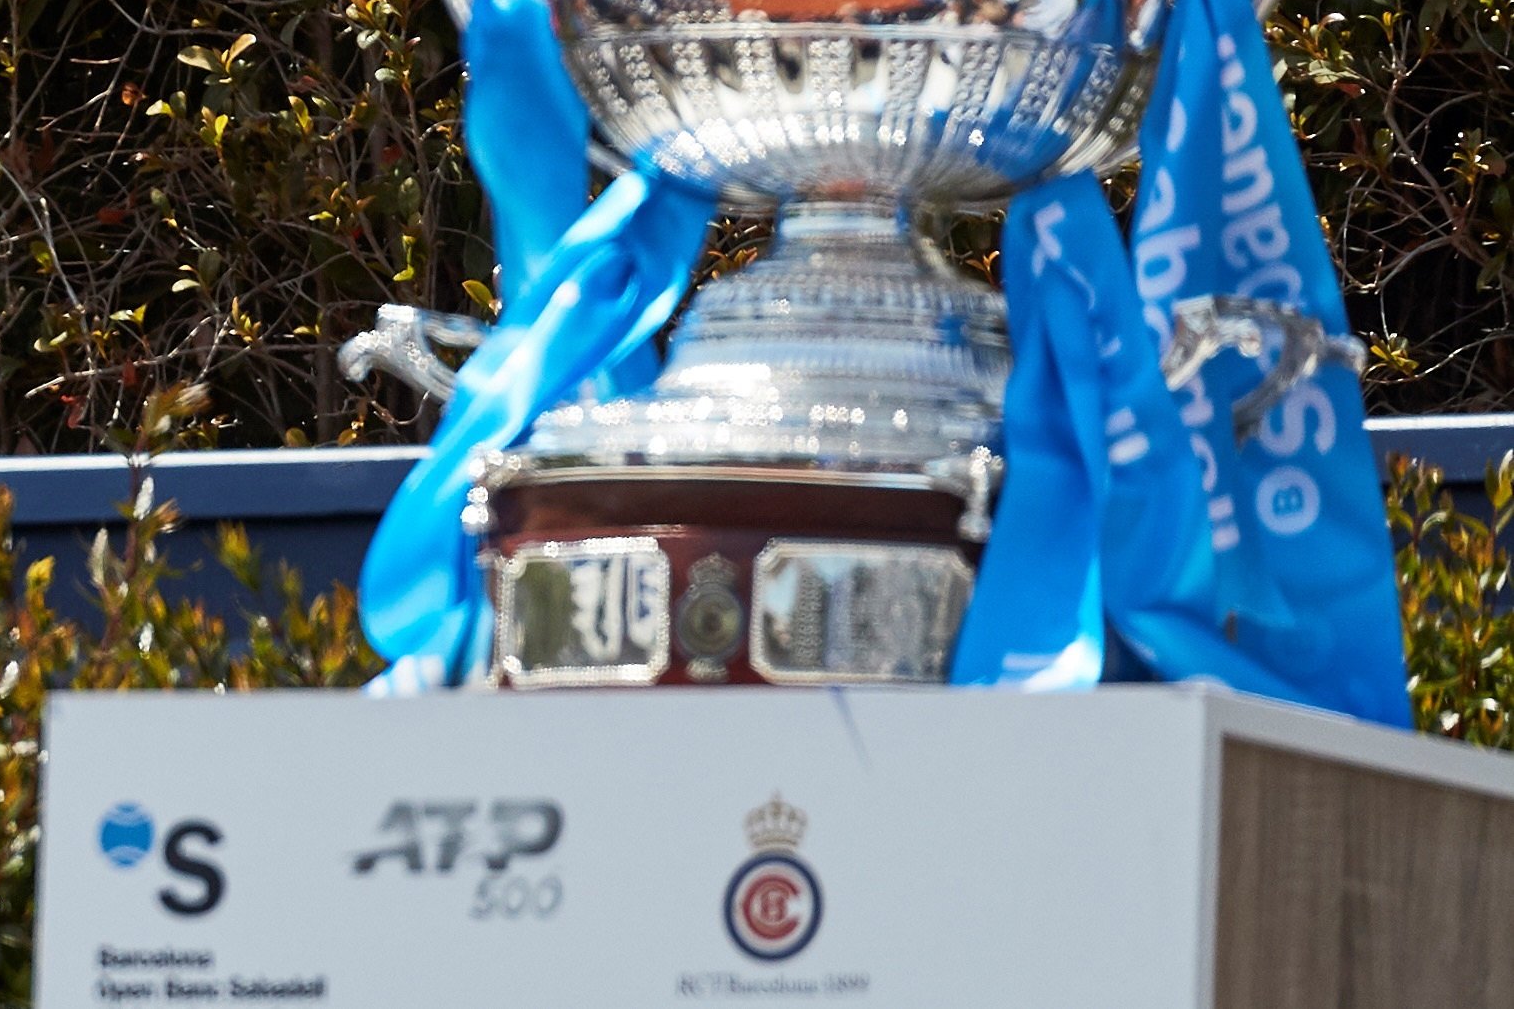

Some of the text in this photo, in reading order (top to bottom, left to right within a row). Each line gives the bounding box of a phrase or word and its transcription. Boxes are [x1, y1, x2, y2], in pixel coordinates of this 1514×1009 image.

[353, 799, 563, 871] ATP
[157, 818, 224, 916] S
[470, 875, 563, 919] 500
[98, 946, 213, 968] Barcelona
[98, 976, 153, 1001] Open
[230, 974, 325, 998] Sabadell
